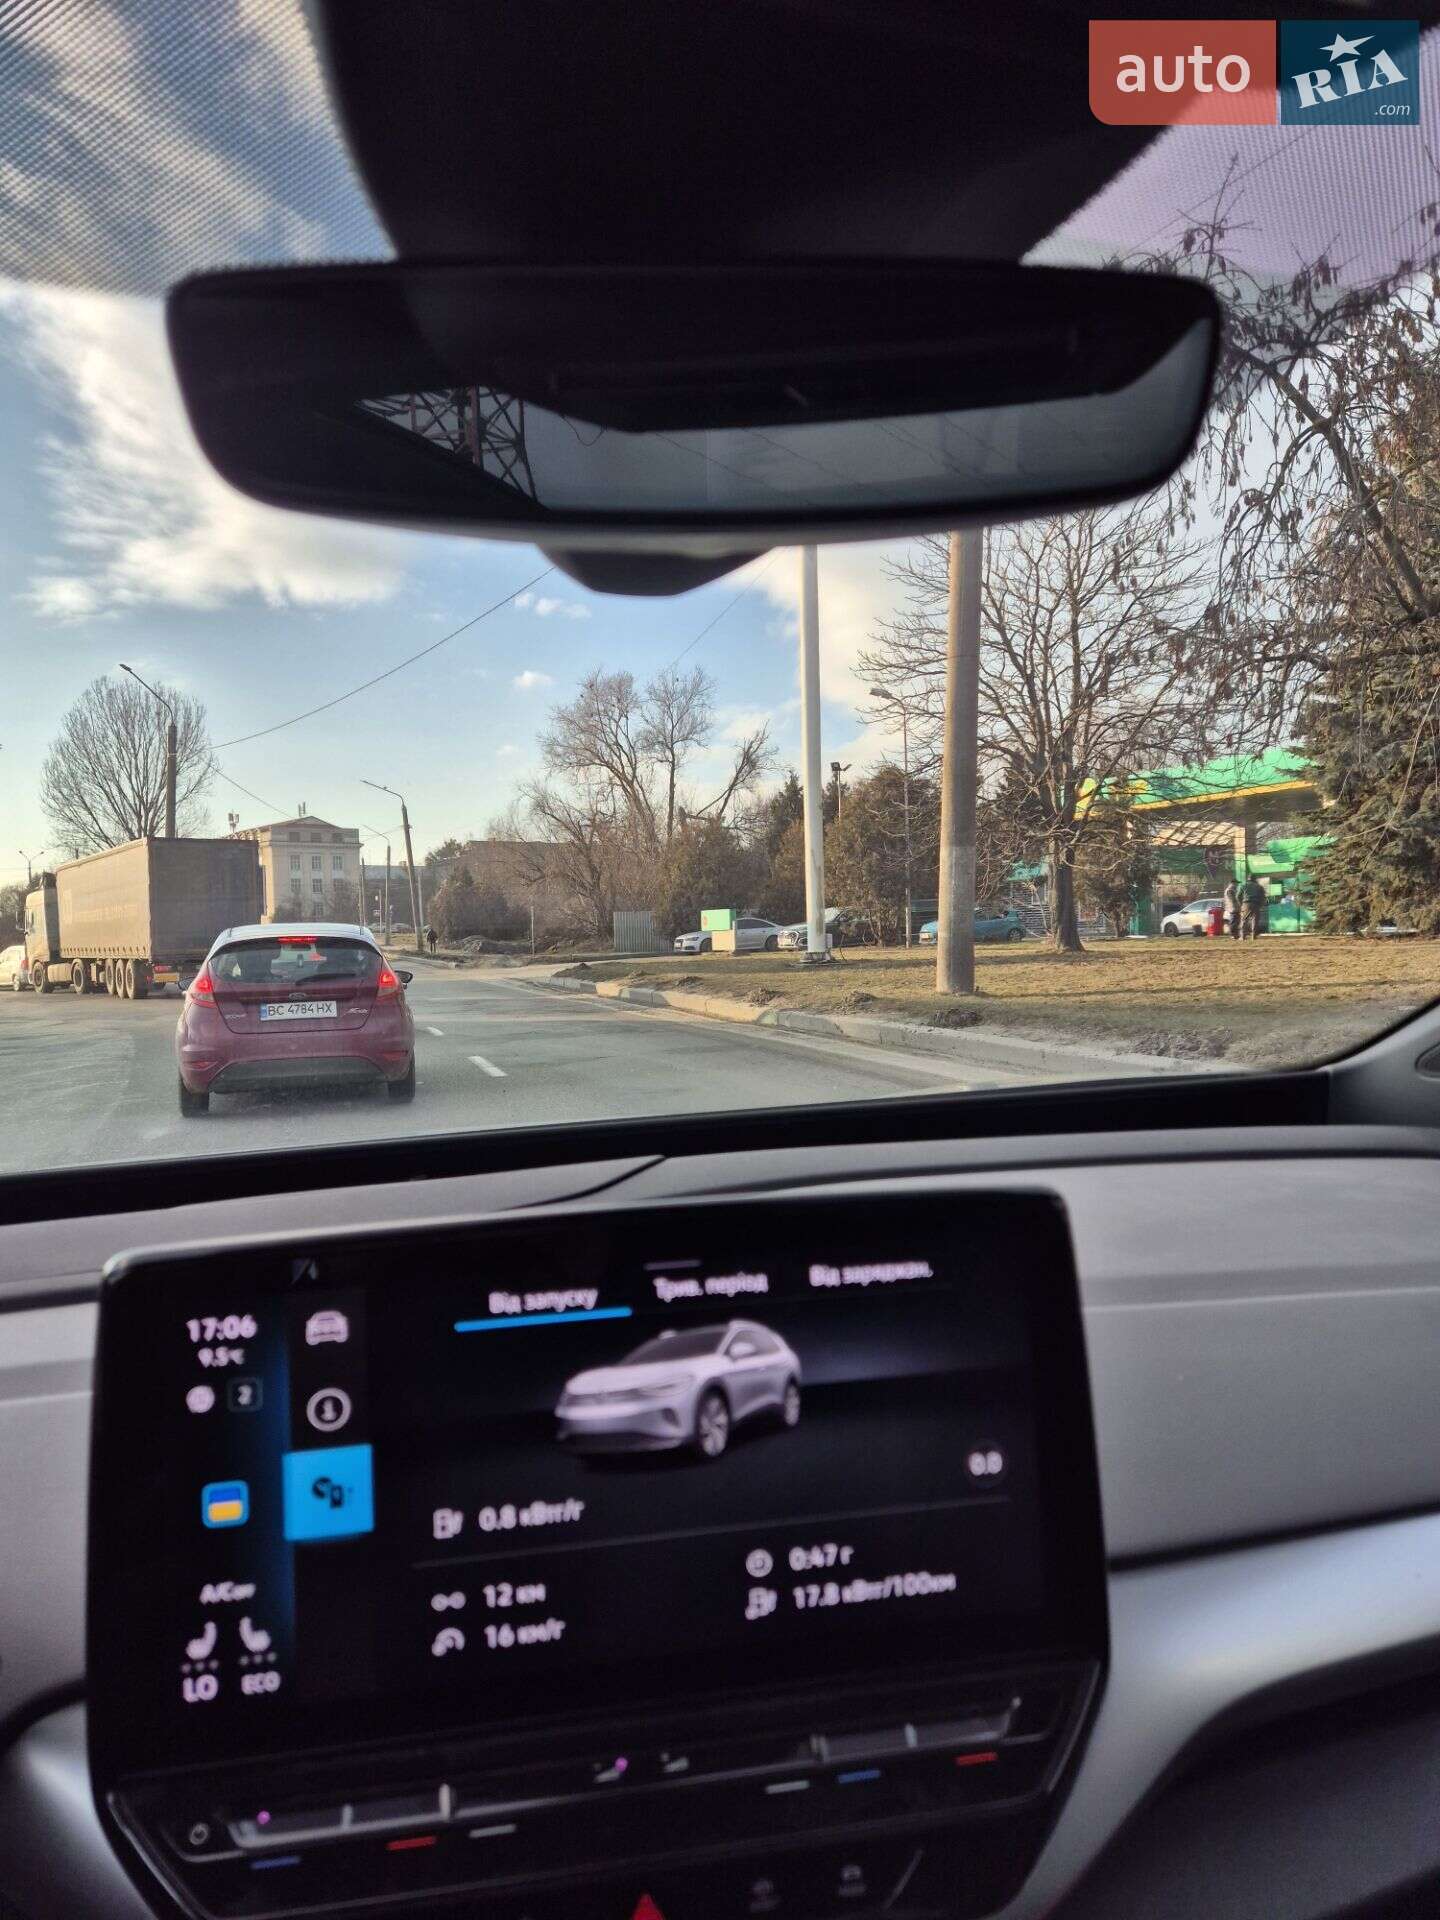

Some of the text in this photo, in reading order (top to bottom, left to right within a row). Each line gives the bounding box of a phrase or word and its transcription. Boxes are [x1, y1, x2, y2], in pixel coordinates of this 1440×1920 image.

[267, 1005, 285, 1017] BC
[316, 1002, 333, 1014] HX
[186, 1314, 258, 1342] 17:06
[478, 1503, 516, 1532] 0.8
[483, 1582, 513, 1608] 12
[793, 1582, 840, 1610] 17.8
[484, 1622, 515, 1649] 16
[182, 1673, 219, 1703] LO
